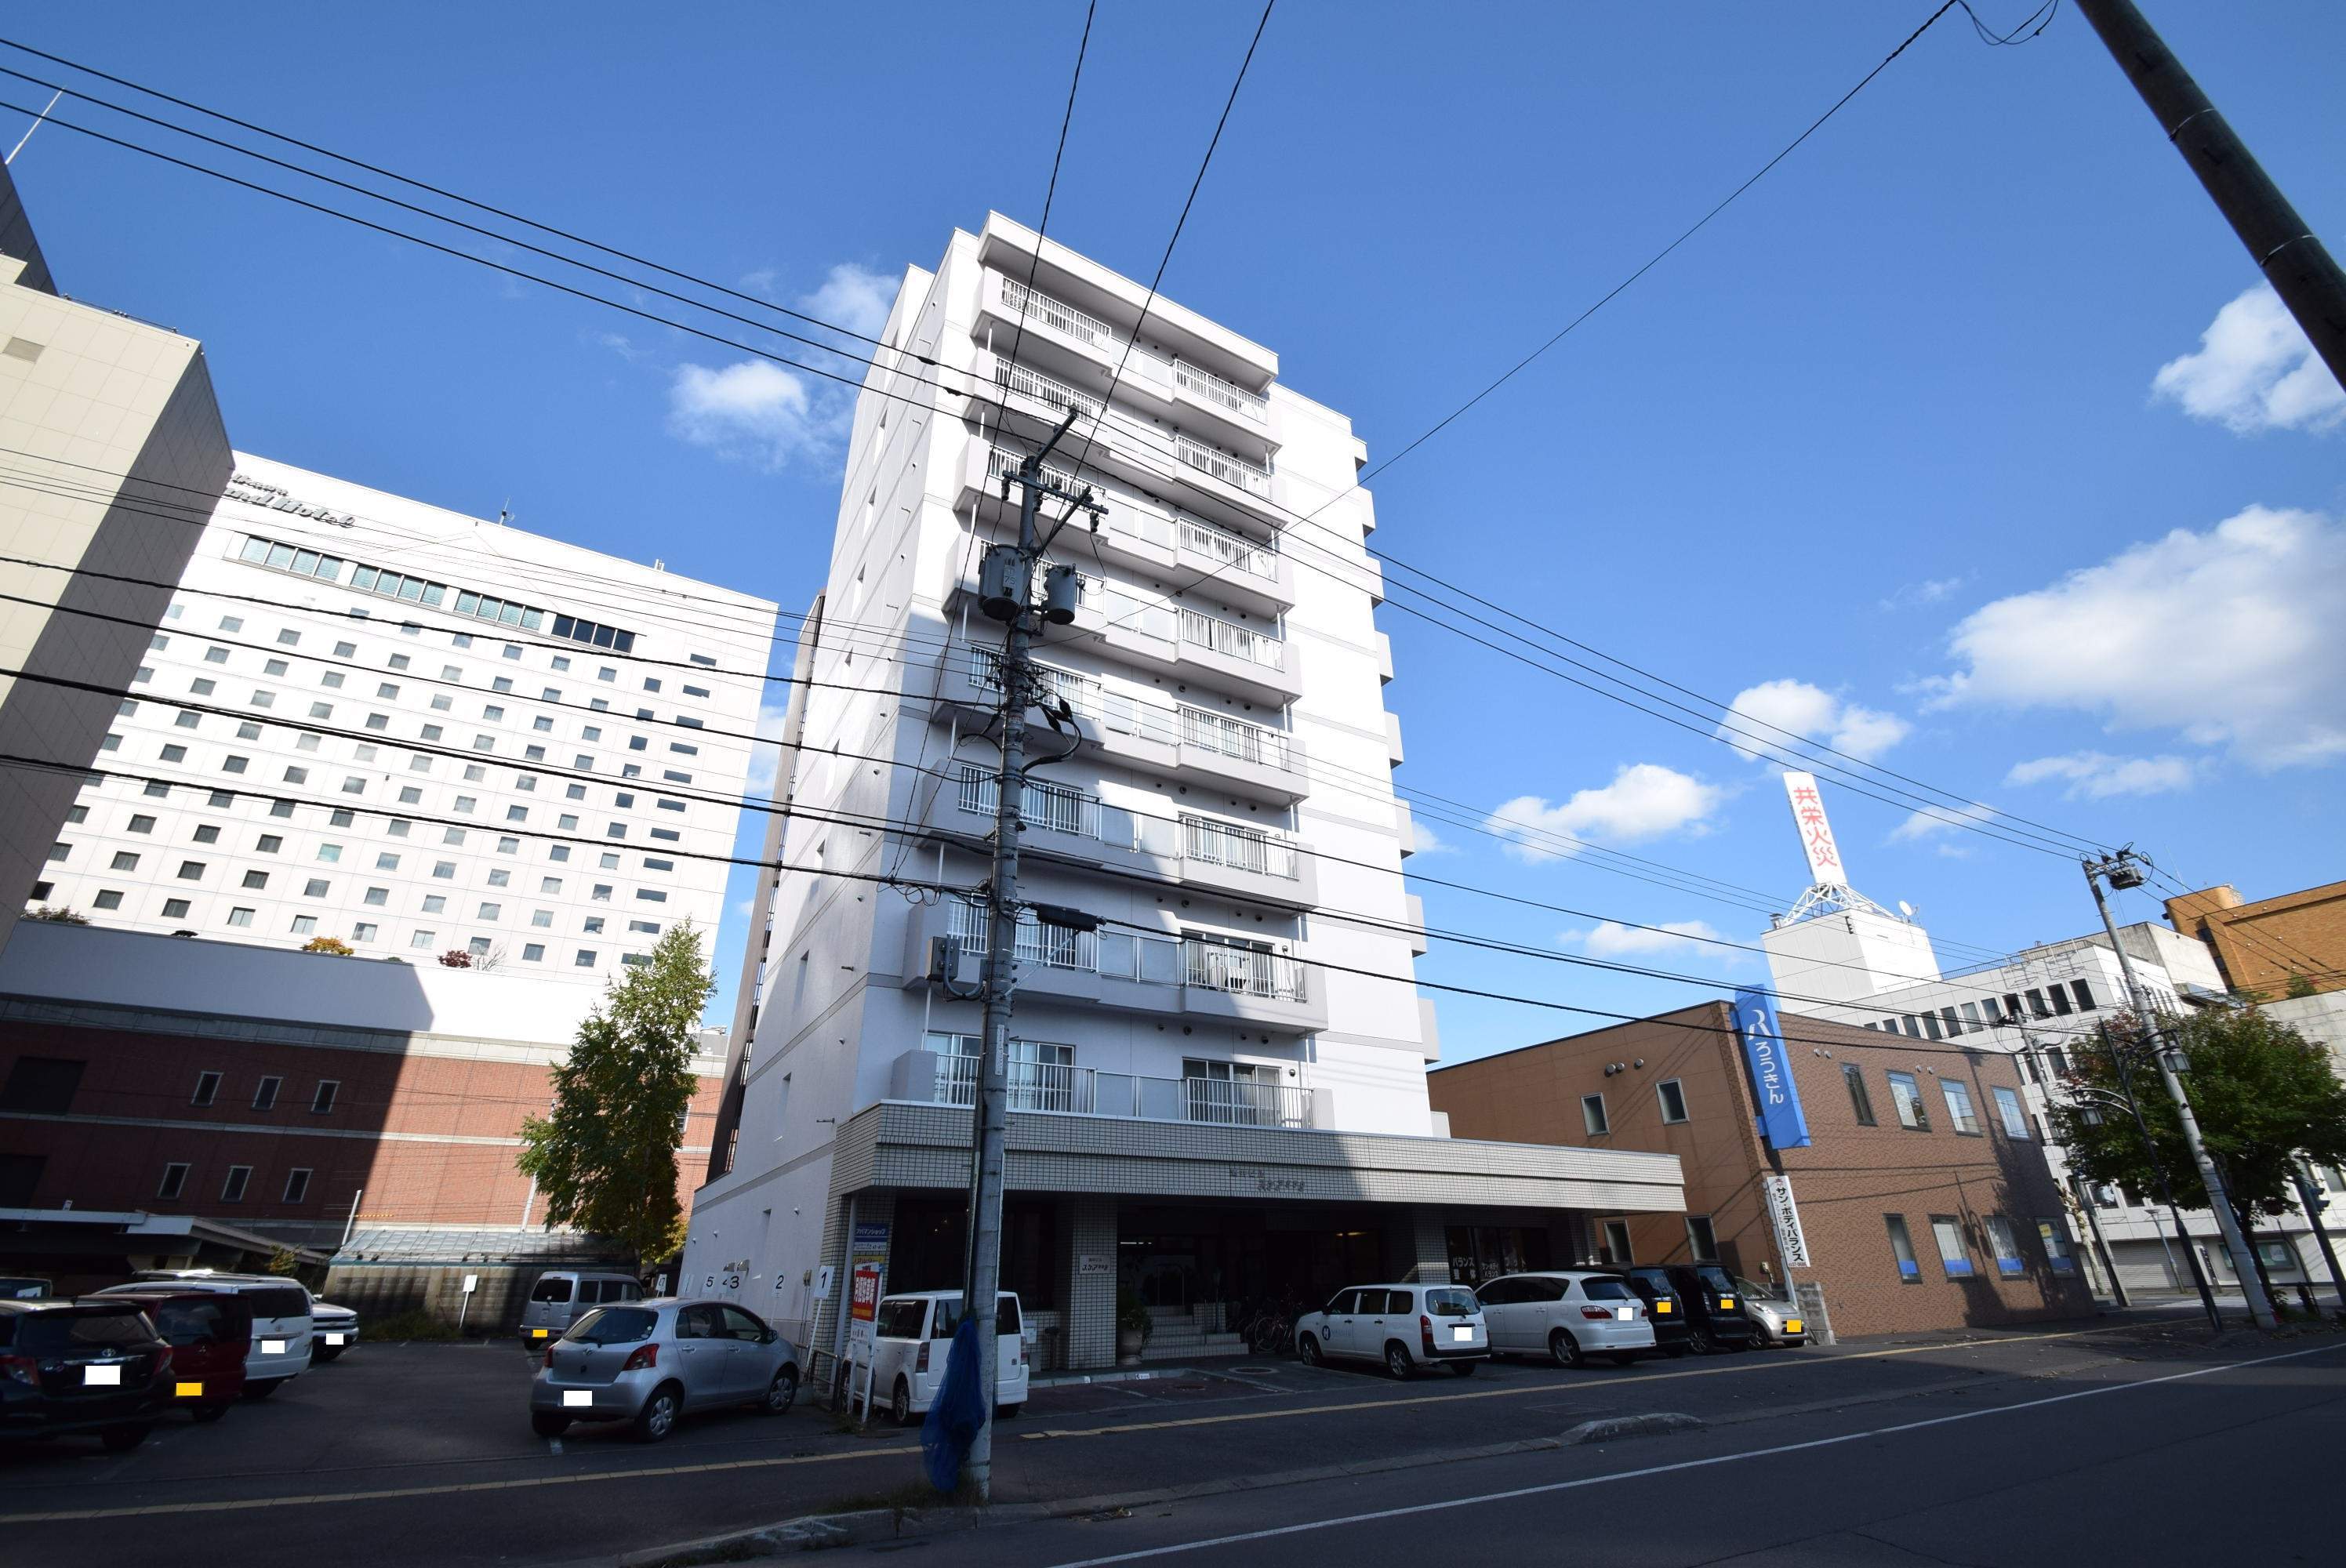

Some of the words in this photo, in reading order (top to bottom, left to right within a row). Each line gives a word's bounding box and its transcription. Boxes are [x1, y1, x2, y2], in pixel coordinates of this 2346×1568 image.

[271, 497, 355, 528] Hotel
[1793, 786, 1837, 867] 共栄火災
[1755, 1041, 1785, 1105] ろうきん
[1452, 1257, 1475, 1268] バランス
[706, 1276, 714, 1287] 5
[729, 1276, 739, 1289] 3
[775, 1275, 783, 1289] 2
[821, 1272, 827, 1288] 1
